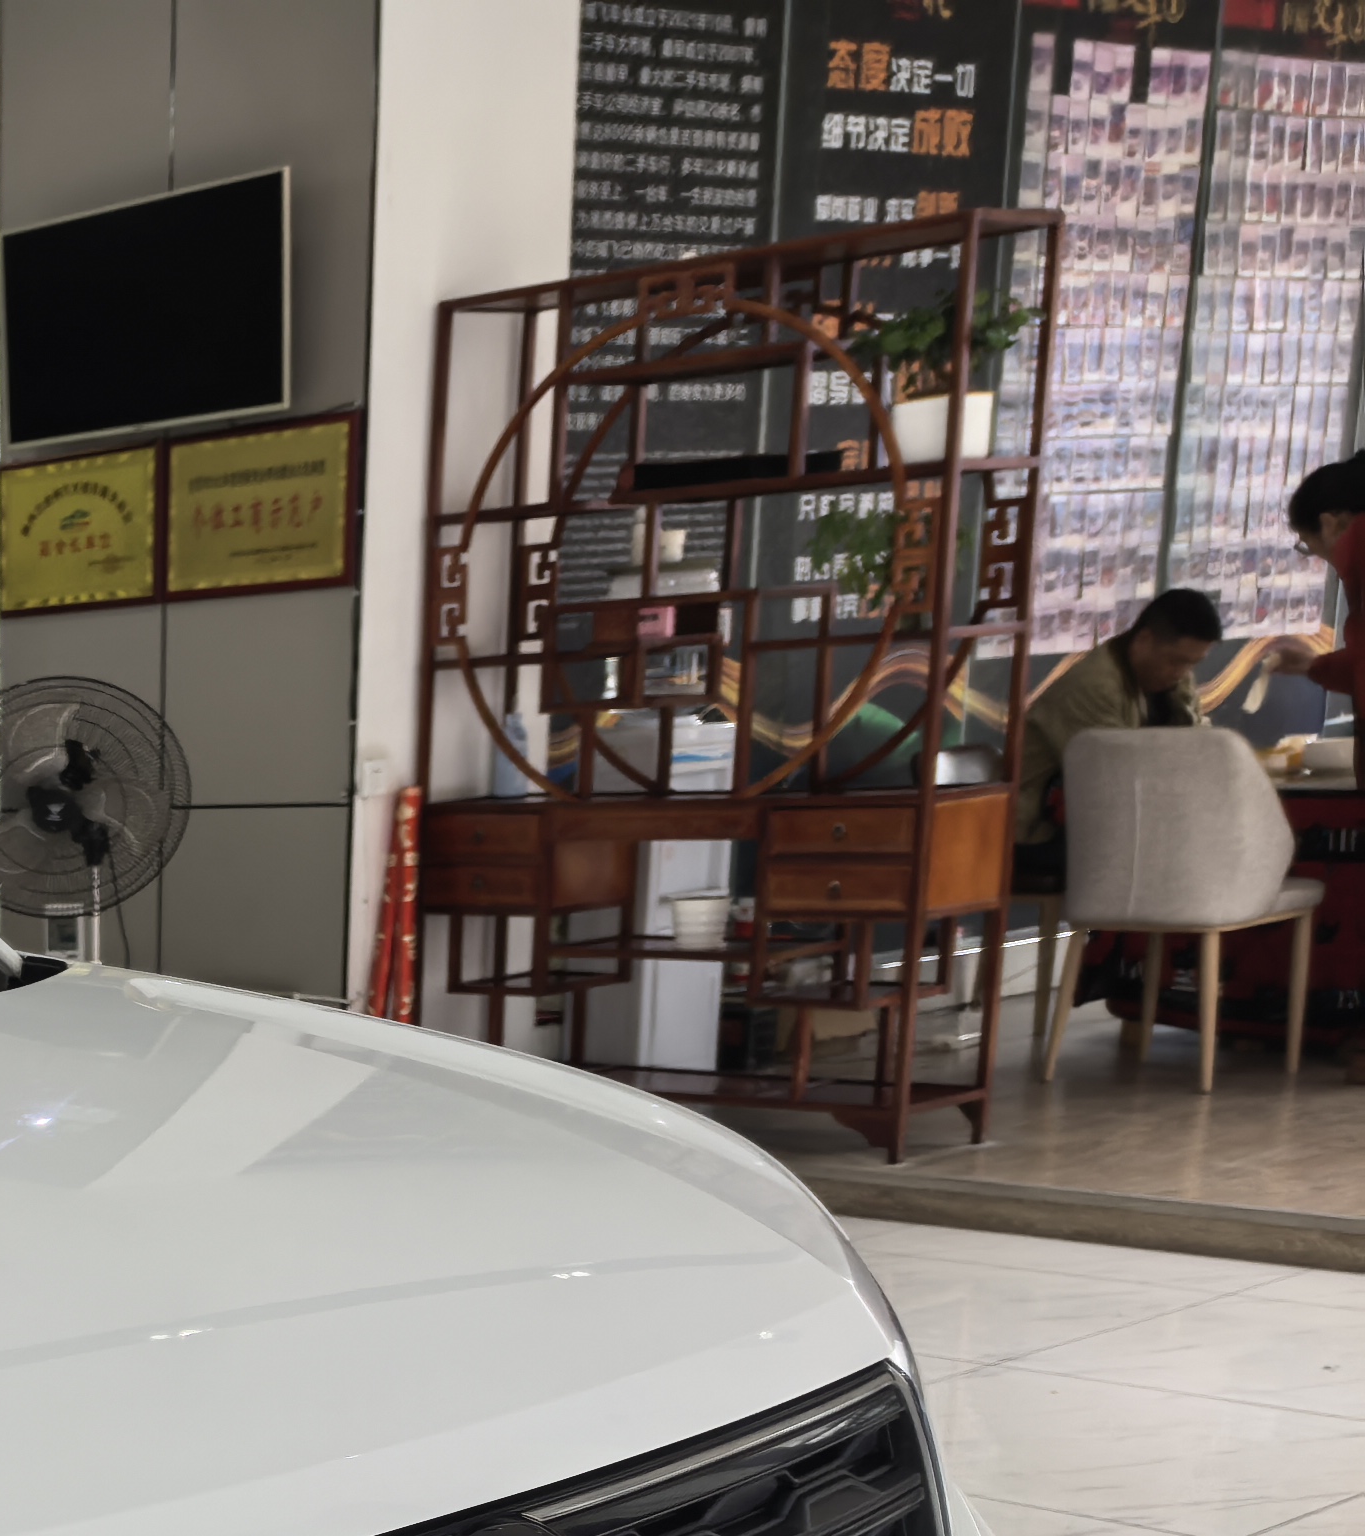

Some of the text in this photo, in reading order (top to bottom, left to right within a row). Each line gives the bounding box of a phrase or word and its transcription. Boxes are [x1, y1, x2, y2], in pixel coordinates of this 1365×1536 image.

[826, 39, 975, 98] 态度决定一切
[822, 108, 974, 156] 细节决定成败
